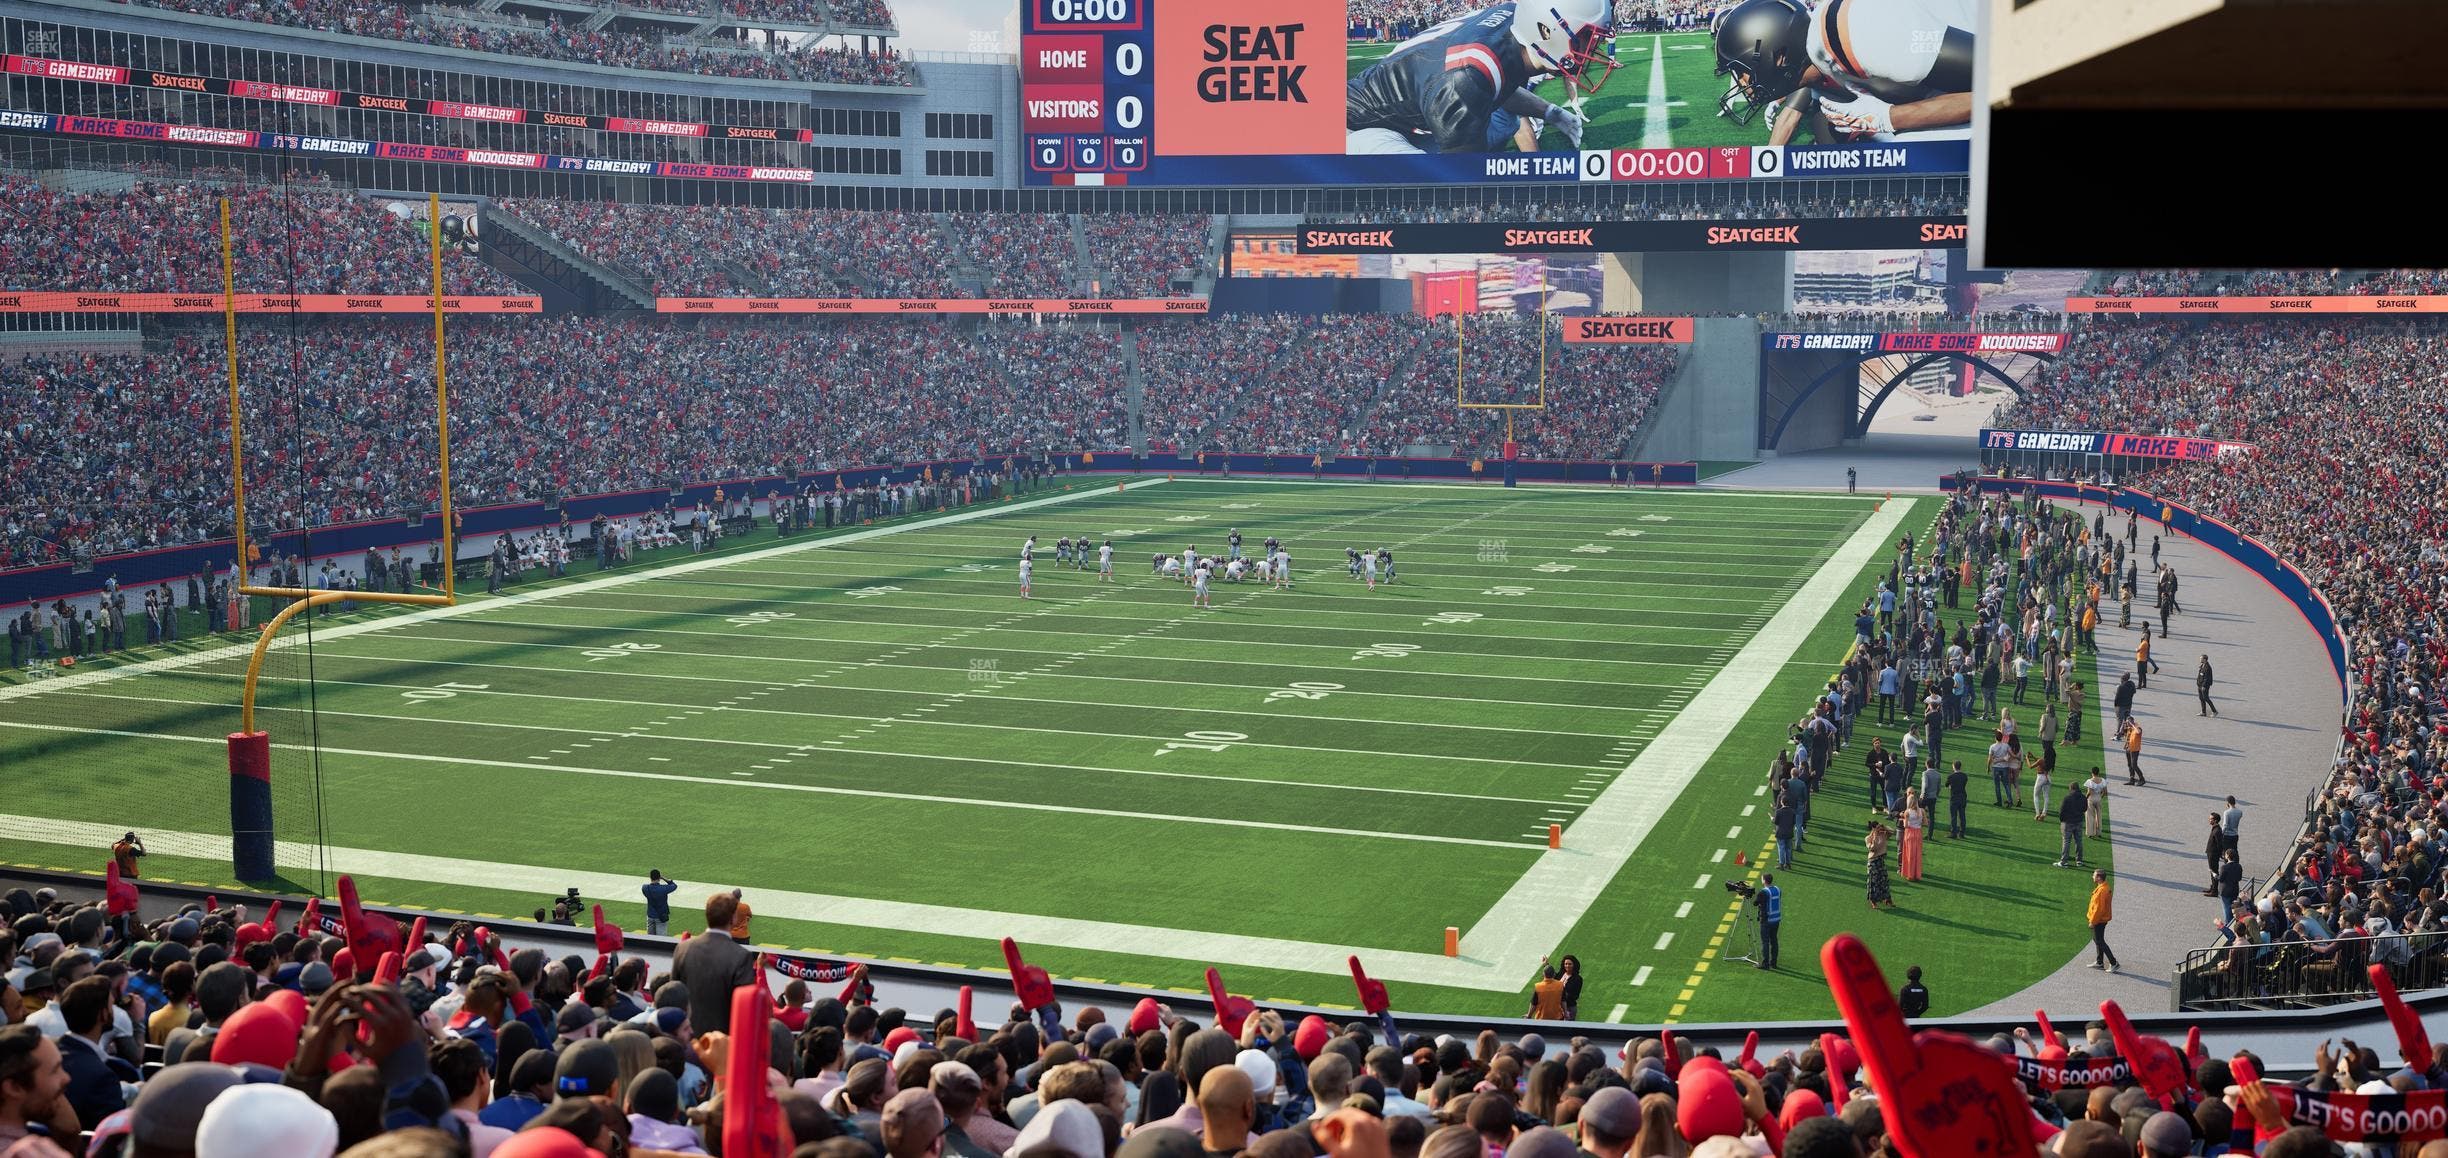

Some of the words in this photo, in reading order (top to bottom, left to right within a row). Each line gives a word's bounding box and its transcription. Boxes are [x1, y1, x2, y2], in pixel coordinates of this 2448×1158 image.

[1052, 0, 1127, 21] 0:00
[1203, 23, 1304, 62] SEAT
[1040, 50, 1087, 68] HOME
[1116, 43, 1143, 76] 0
[20, 58, 46, 73] IT'S
[49, 62, 117, 81] GAMEDAY!
[152, 73, 207, 92] SEATGEEK
[1197, 65, 1308, 103] GEEK
[247, 84, 268, 97] IT'S
[271, 87, 329, 103] GAMEDAY!
[359, 95, 408, 111] SEATGEEK
[442, 103, 462, 115] IT'S
[464, 106, 516, 121] GAMEDAY!
[543, 113, 588, 127] SEATGEEK
[1028, 100, 1099, 118] VISITORS
[1116, 96, 1143, 129] 0
[71, 119, 117, 134] MAKE
[123, 123, 165, 138] SOME
[623, 119, 643, 131] IT'S
[645, 122, 698, 136] GAMEDAY!
[727, 127, 777, 140] SEATGEEK
[272, 135, 298, 149] IT'S
[301, 138, 370, 154] GAMEDAY!
[1721, 148, 1739, 157] QRT
[388, 145, 426, 158] MAKE
[431, 148, 464, 161] SOME
[467, 151, 536, 166] NOOOOISE!!!
[1042, 148, 1057, 164] 0
[1082, 148, 1096, 164] 0
[1122, 148, 1136, 164] 0
[1617, 151, 1704, 176] 00:00
[1758, 149, 1777, 173] 0
[1791, 149, 1860, 169] VISITORS
[1864, 149, 1906, 167] TEAM
[559, 158, 583, 170] IT'S
[586, 160, 652, 174] GAMEDAY!
[670, 165, 708, 176] MAKE
[712, 167, 749, 178] SOME
[1486, 158, 1529, 175] HOME
[1533, 157, 1575, 175] TEAM
[1586, 153, 1605, 177] 0
[1726, 159, 1734, 174] 1
[1306, 230, 1394, 247] SEATGEEK
[1504, 228, 1593, 247] SEATGEEK
[1707, 225, 1800, 245] SEATGEEK
[77, 297, 121, 307] SEATGEEK
[174, 297, 213, 307] SEATGEEK
[262, 298, 300, 308] SEATGEEK
[347, 298, 382, 308] SEATGEEK
[426, 299, 461, 308] SEGEEK
[502, 299, 534, 309] SEATGEEK
[684, 301, 714, 309] SEATGEEK
[749, 301, 779, 310] SEATGEEK
[818, 301, 852, 310] SEATGEEK
[899, 301, 937, 310] SEATGEEK
[988, 302, 1034, 310] SEATGEEK
[1068, 302, 1113, 310] SEATGEEK
[1165, 302, 1207, 310] SEATGEEK
[2095, 300, 2132, 309] SEATGEEK
[2179, 300, 2219, 309] SEATGEEK
[2270, 300, 2312, 309] SEATGEEK
[2376, 300, 2417, 309] SEATGEEK
[1581, 320, 1674, 340] SEATGEEK
[1775, 335, 1800, 348] IT'S
[1803, 335, 1873, 349] GAMEDAY!
[1892, 335, 1934, 348] MAKE
[1939, 335, 1977, 348] SOME
[1979, 335, 2058, 350] NOOOOISE!!!
[1987, 431, 2015, 448] IT'S
[2018, 433, 2095, 451] GAMEDAY!
[2121, 438, 2180, 456] MAKE
[2186, 441, 2216, 461] SOME
[580, 642, 662, 658] 20
[401, 682, 490, 699] 10
[1269, 682, 1346, 700] 20
[1164, 731, 1249, 752] 10
[320, 917, 343, 935] LET'S
[776, 958, 799, 976] LET'S
[2018, 1059, 2056, 1083] LET'S
[2294, 1093, 2355, 1132] LET'S
